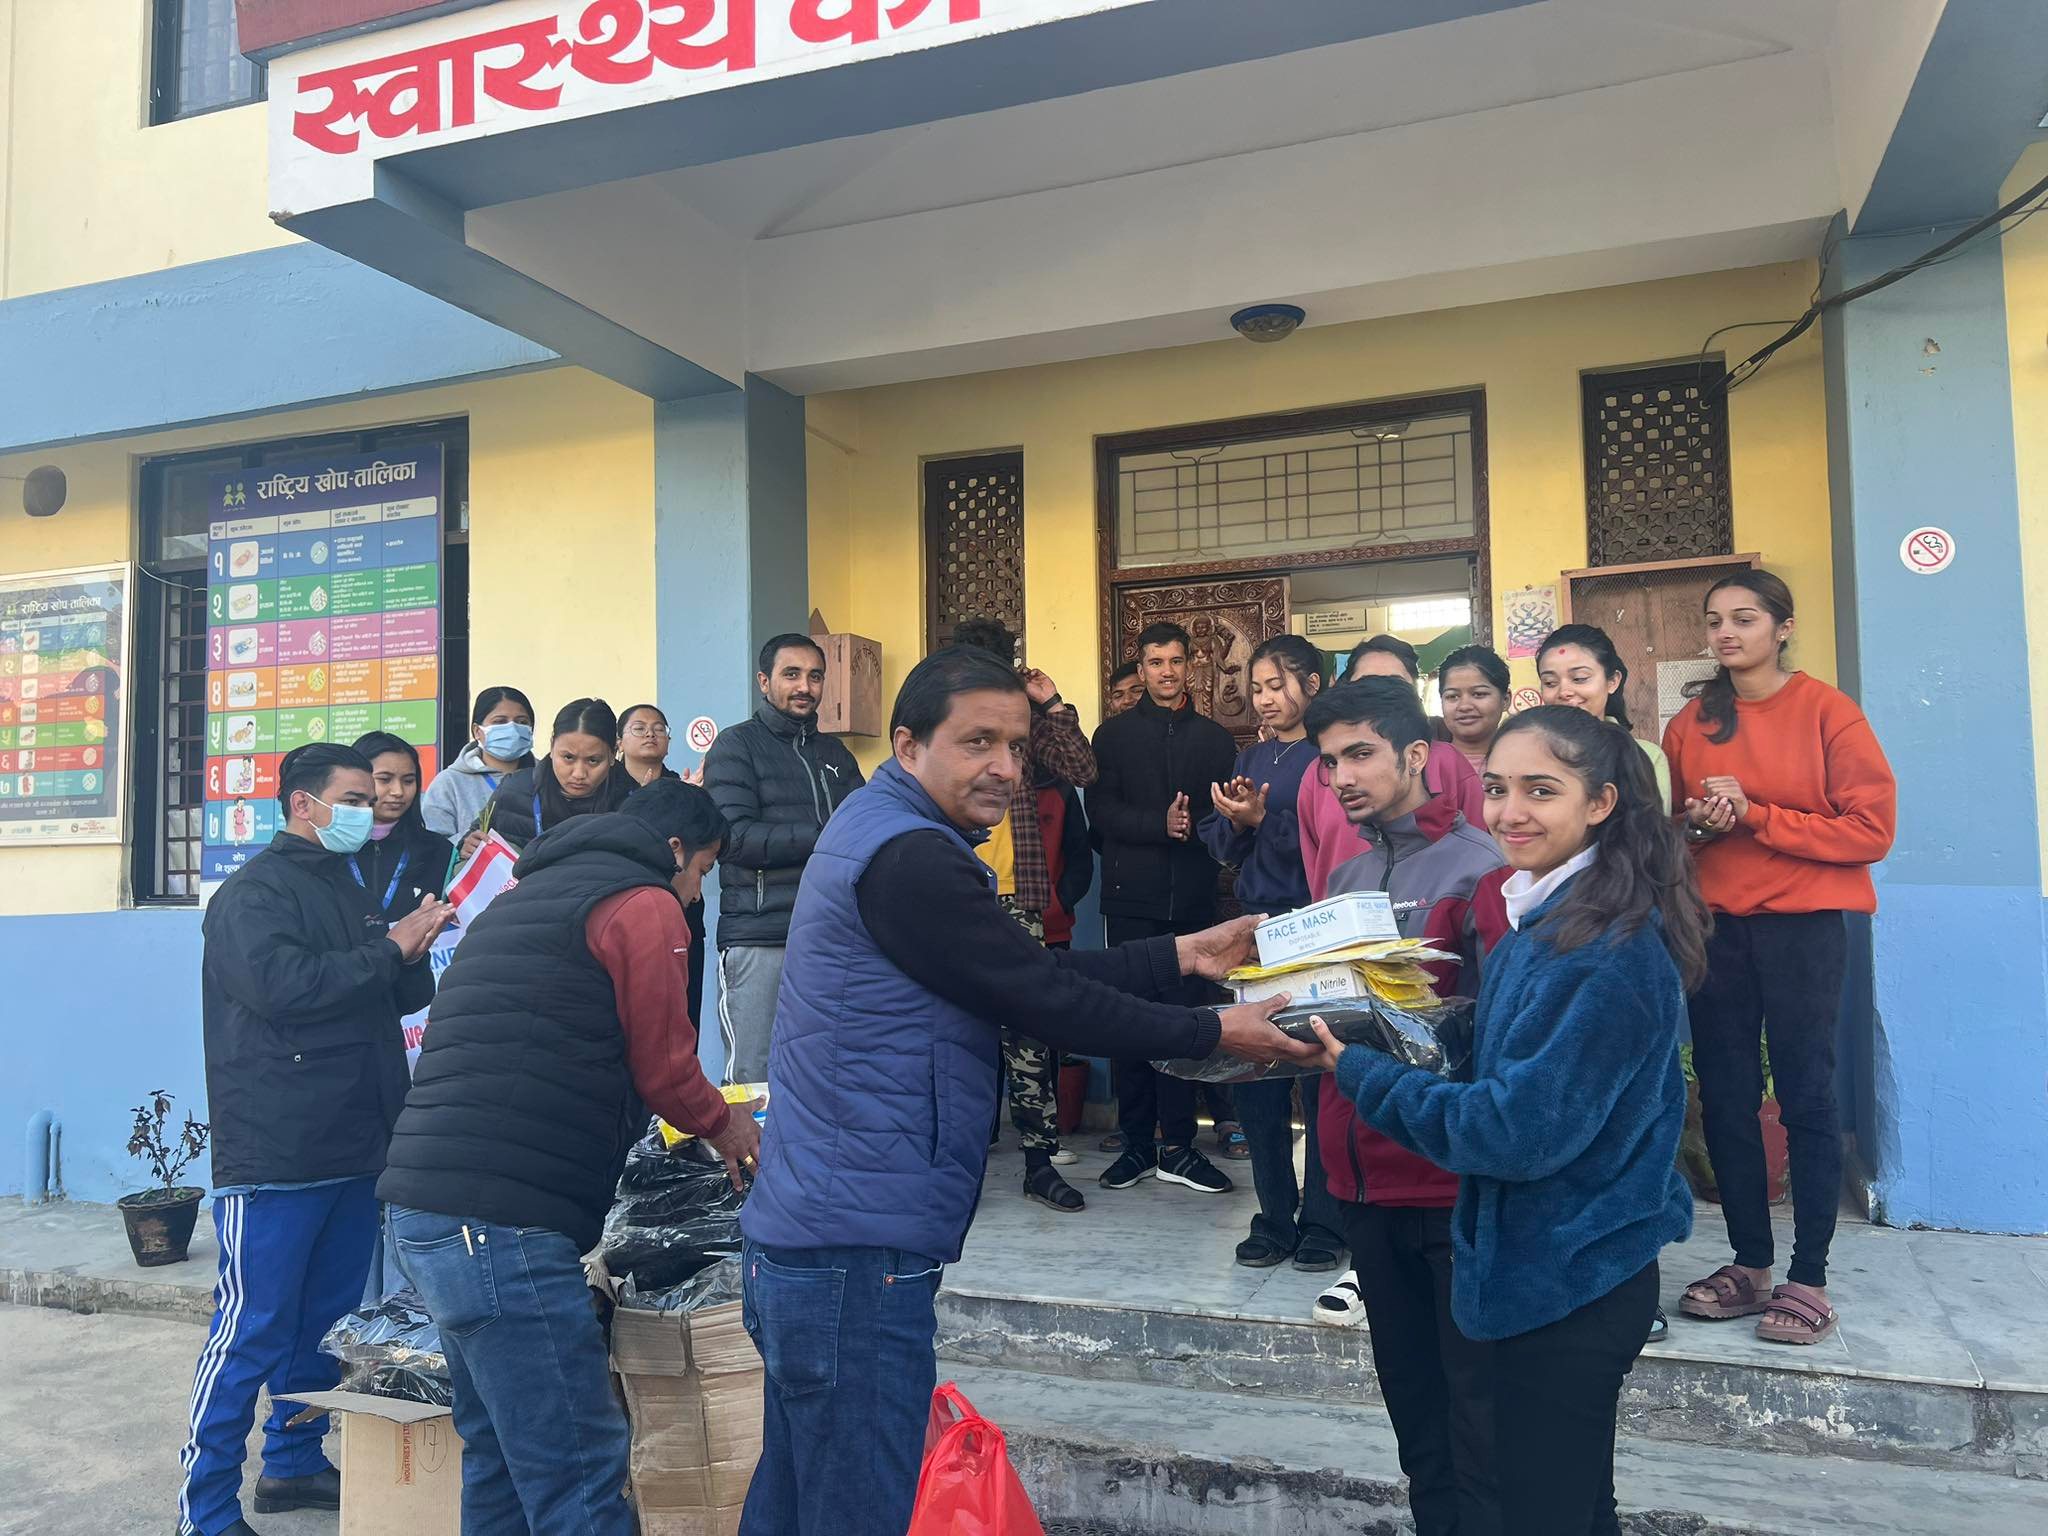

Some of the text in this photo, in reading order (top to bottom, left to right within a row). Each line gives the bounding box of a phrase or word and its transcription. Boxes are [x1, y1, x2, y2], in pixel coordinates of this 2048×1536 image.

[256, 473, 310, 500] राष्ट्रिय
[214, 551, 223, 577] १
[213, 594, 222, 618] २
[213, 633, 222, 661] ३
[211, 721, 221, 749] ५
[210, 765, 219, 794] ६
[209, 812, 218, 839] ७
[1267, 909, 1337, 942] FACE MASK
[1319, 977, 1347, 991] Nitrile
